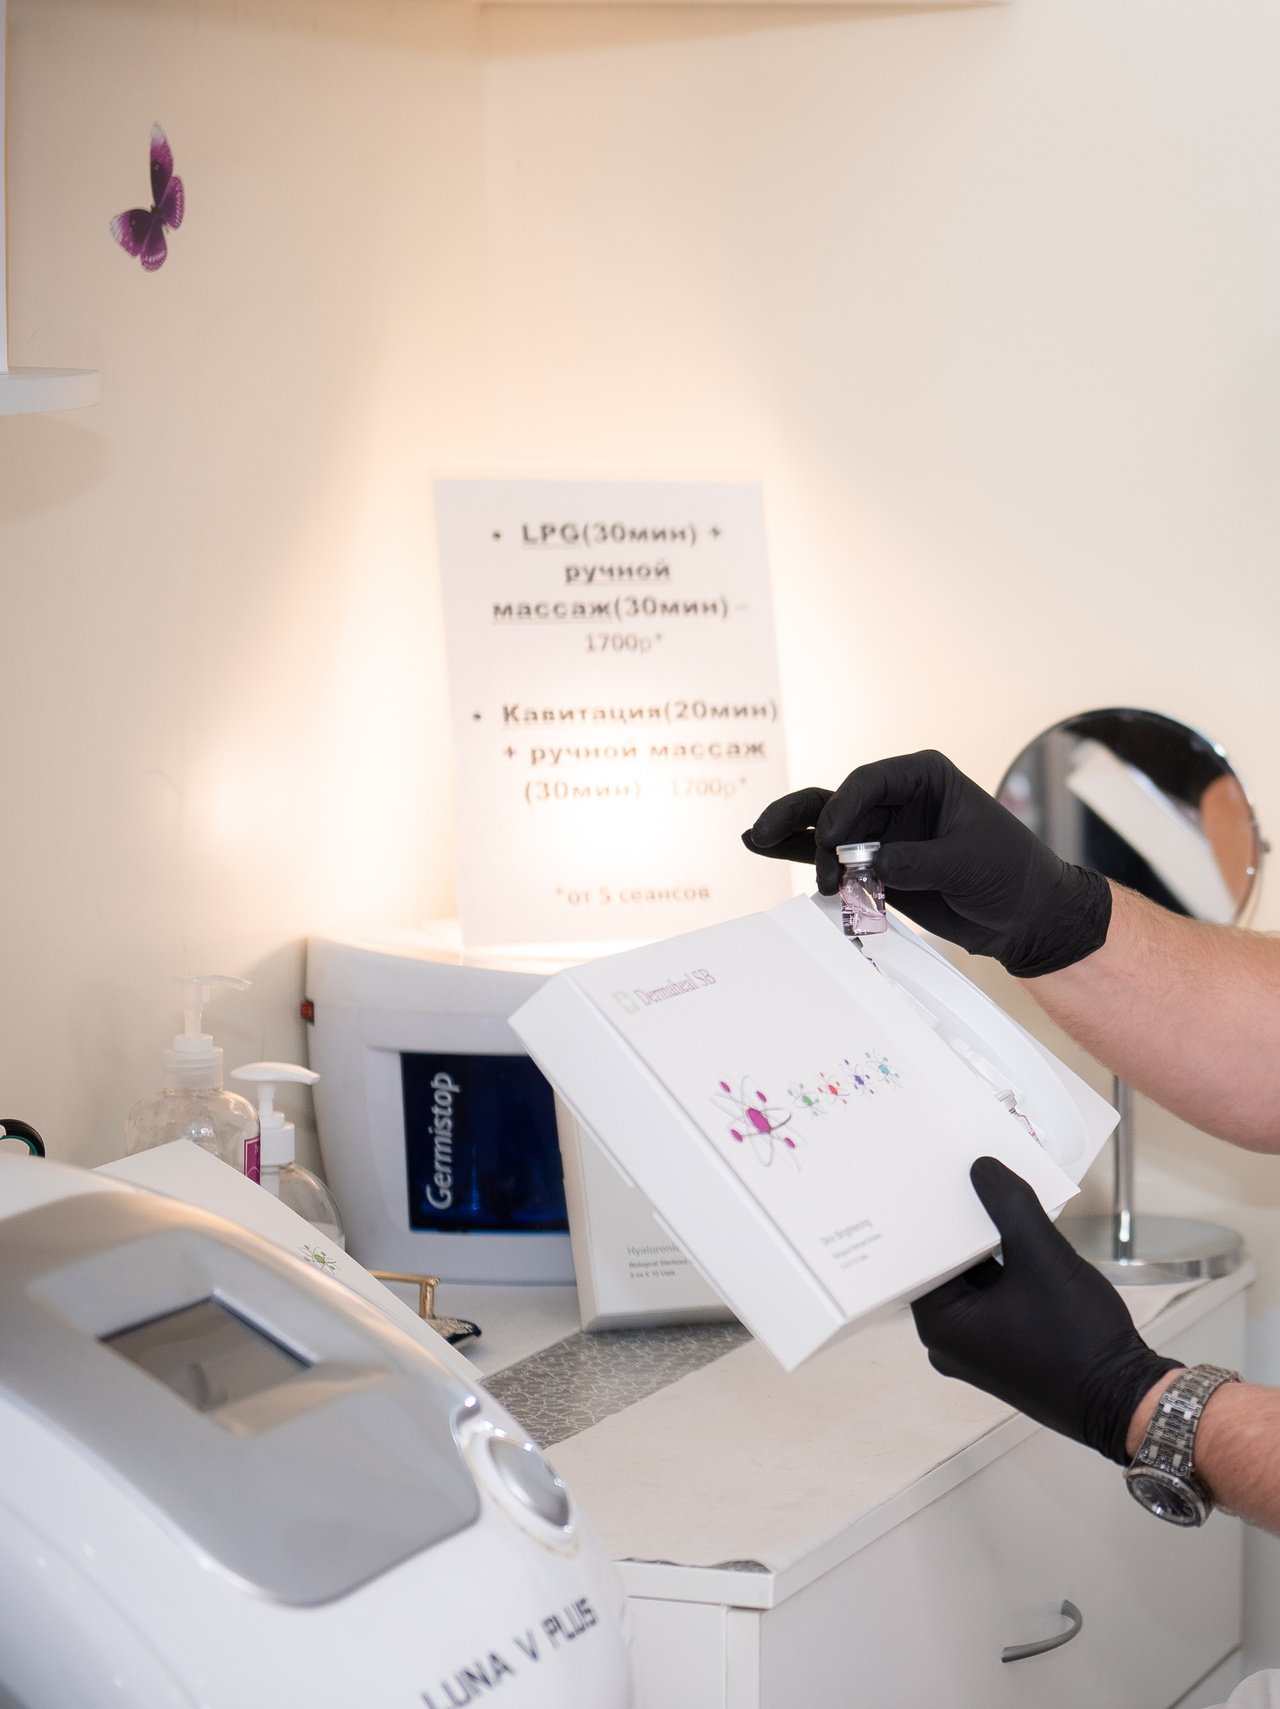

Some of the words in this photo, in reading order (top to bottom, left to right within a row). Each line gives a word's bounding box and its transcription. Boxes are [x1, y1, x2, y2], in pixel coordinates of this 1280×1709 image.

[520, 522, 697, 547] LPG(30мин)
[563, 558, 672, 584] ручной
[492, 595, 728, 623] массаж(30мин)
[502, 700, 778, 727] Кавитация(20мин)
[530, 739, 638, 767] ручной
[650, 739, 767, 760] массаж
[619, 883, 711, 903] сеансов
[633, 973, 700, 1006] Dermaheal
[691, 968, 717, 987] SB
[425, 1071, 461, 1210] Germistop
[421, 1651, 516, 1709] LUNA
[512, 1628, 541, 1662] V
[540, 1597, 599, 1651] PLUS
